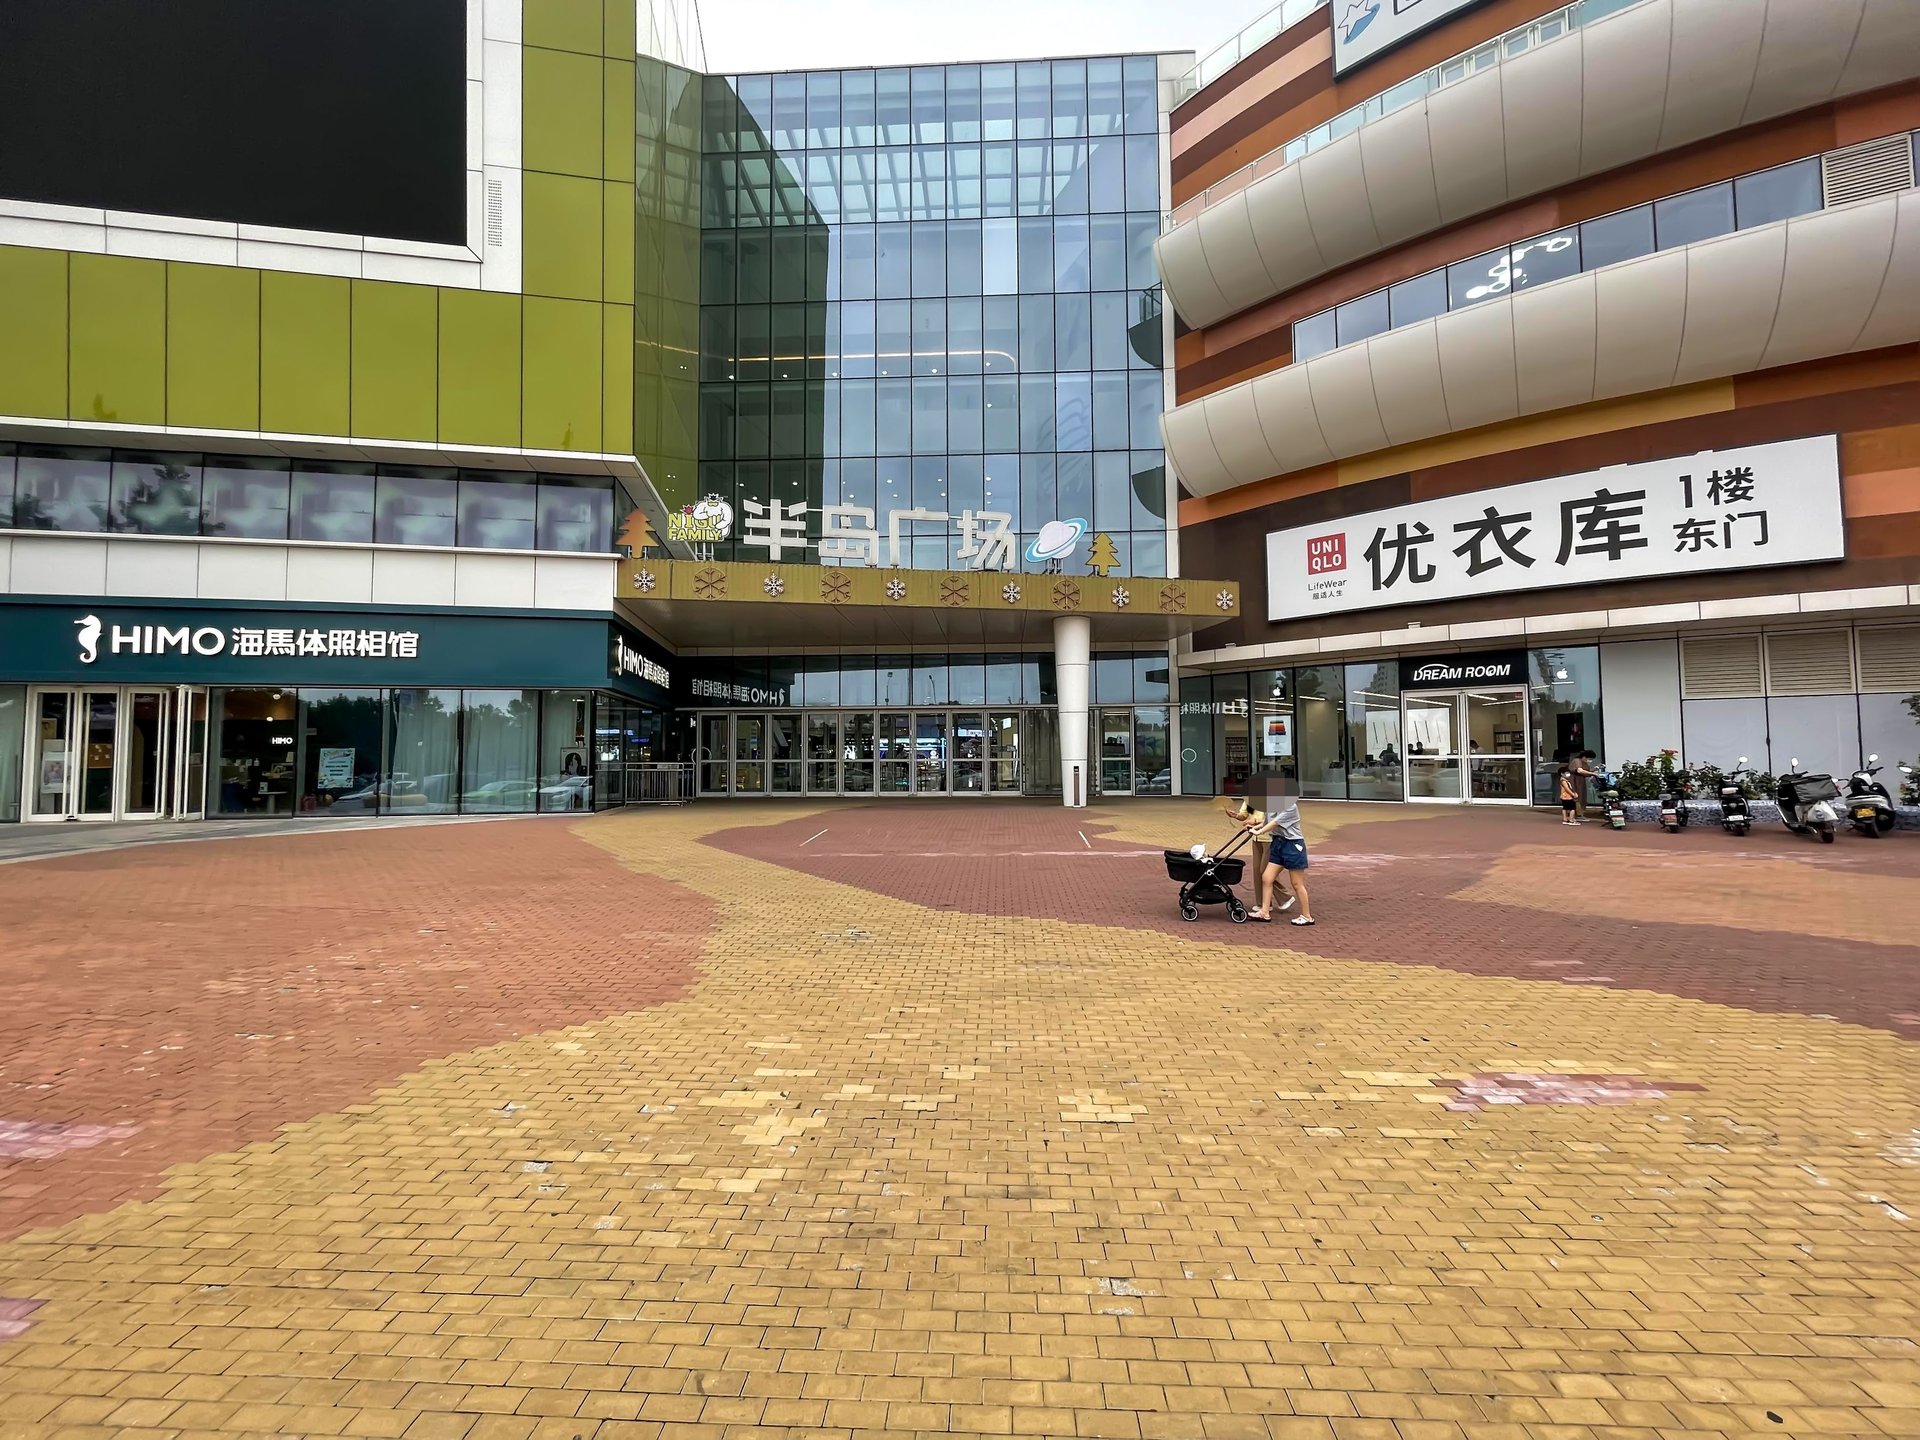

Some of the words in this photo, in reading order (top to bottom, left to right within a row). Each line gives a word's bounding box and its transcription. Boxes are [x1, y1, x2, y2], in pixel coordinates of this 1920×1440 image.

[1679, 466, 1754, 508] 1楼
[668, 528, 721, 541] FAMILY
[743, 499, 1016, 570] 半岛广场
[1311, 538, 1339, 555] UNI
[1363, 488, 1648, 591] 优衣库
[1673, 510, 1768, 553] 东门
[1312, 553, 1342, 571] QLO
[1308, 579, 1347, 591] LifeWear
[112, 625, 226, 656] HIMO
[231, 627, 419, 658] 海馬体照相馆
[623, 645, 644, 677] HIMO
[1413, 666, 1463, 681] DREAM
[1465, 664, 1511, 678] ROOM
